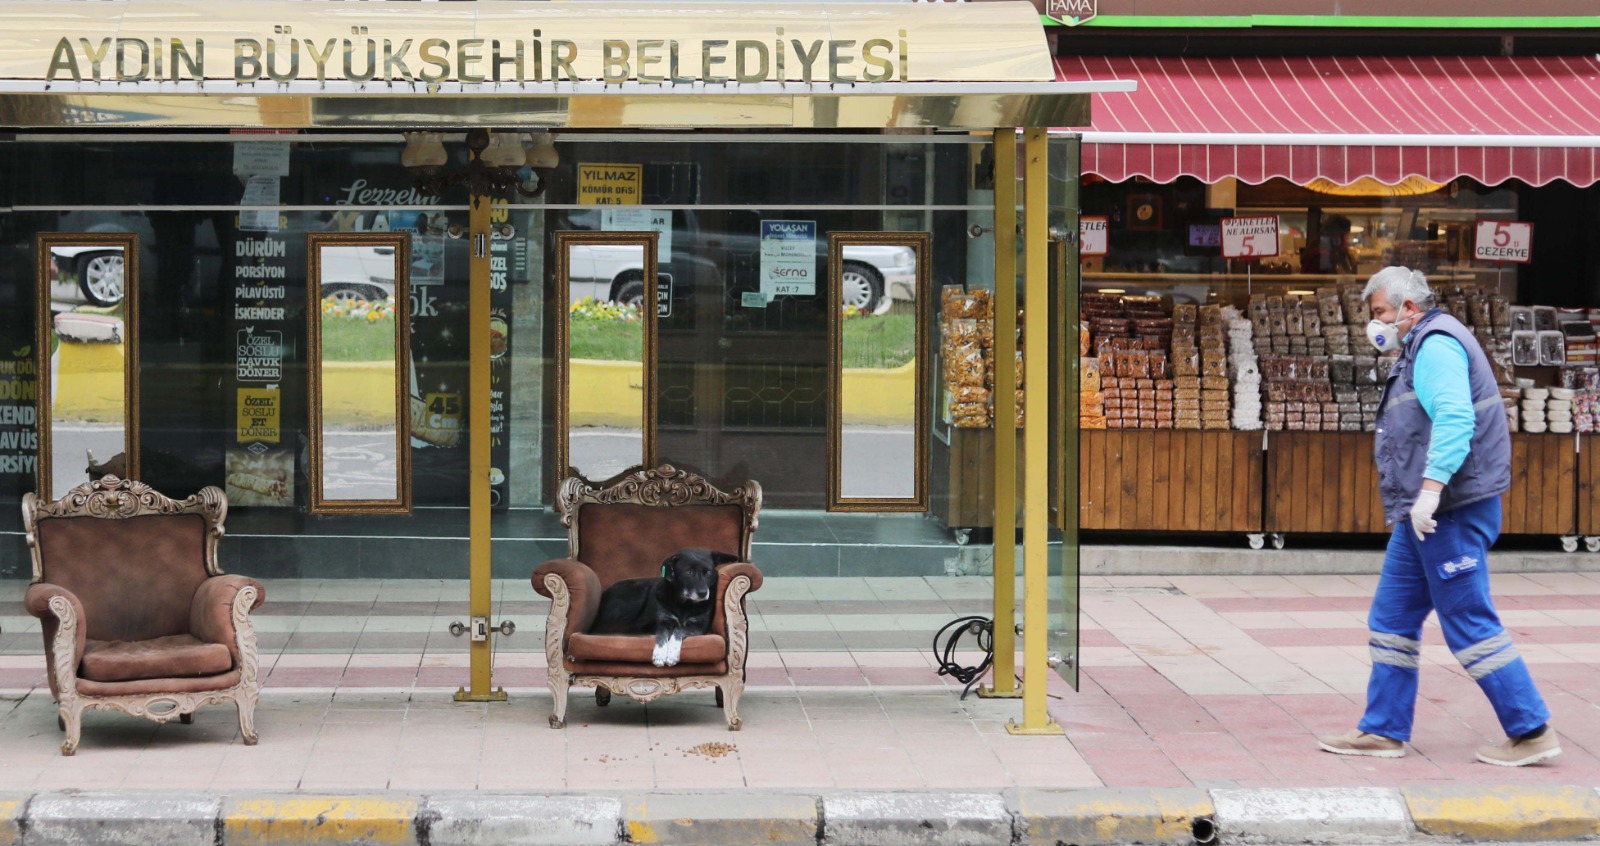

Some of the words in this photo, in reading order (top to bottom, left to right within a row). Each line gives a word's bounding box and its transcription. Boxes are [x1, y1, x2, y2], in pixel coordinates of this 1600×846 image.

[46, 36, 204, 82] AYDIN
[234, 25, 579, 93] BÜYÜKŞEHİR
[603, 27, 907, 85] BELEDİYESİ
[583, 170, 636, 181] YILMAZ
[582, 184, 613, 194] KÖMÜR
[616, 197, 622, 205] 5
[1226, 228, 1239, 236] NE
[1240, 226, 1276, 235] ALIRSAN
[1493, 221, 1511, 247] 5
[236, 237, 285, 257] DÜRÜM
[1240, 235, 1255, 256] 5
[1477, 246, 1528, 258] CEZERYE
[235, 263, 285, 278] PORSİYON
[235, 303, 284, 320] İSKENDER
[246, 334, 275, 346] ÖZEL
[238, 345, 280, 357] SOSLU
[238, 358, 280, 367] TAVUK
[238, 364, 280, 377] DÖNER
[244, 395, 274, 407] ÖZEL
[428, 397, 460, 414] 45
[242, 408, 275, 416] SOSLU
[251, 417, 267, 427] ET
[241, 425, 278, 437] DÖNER
